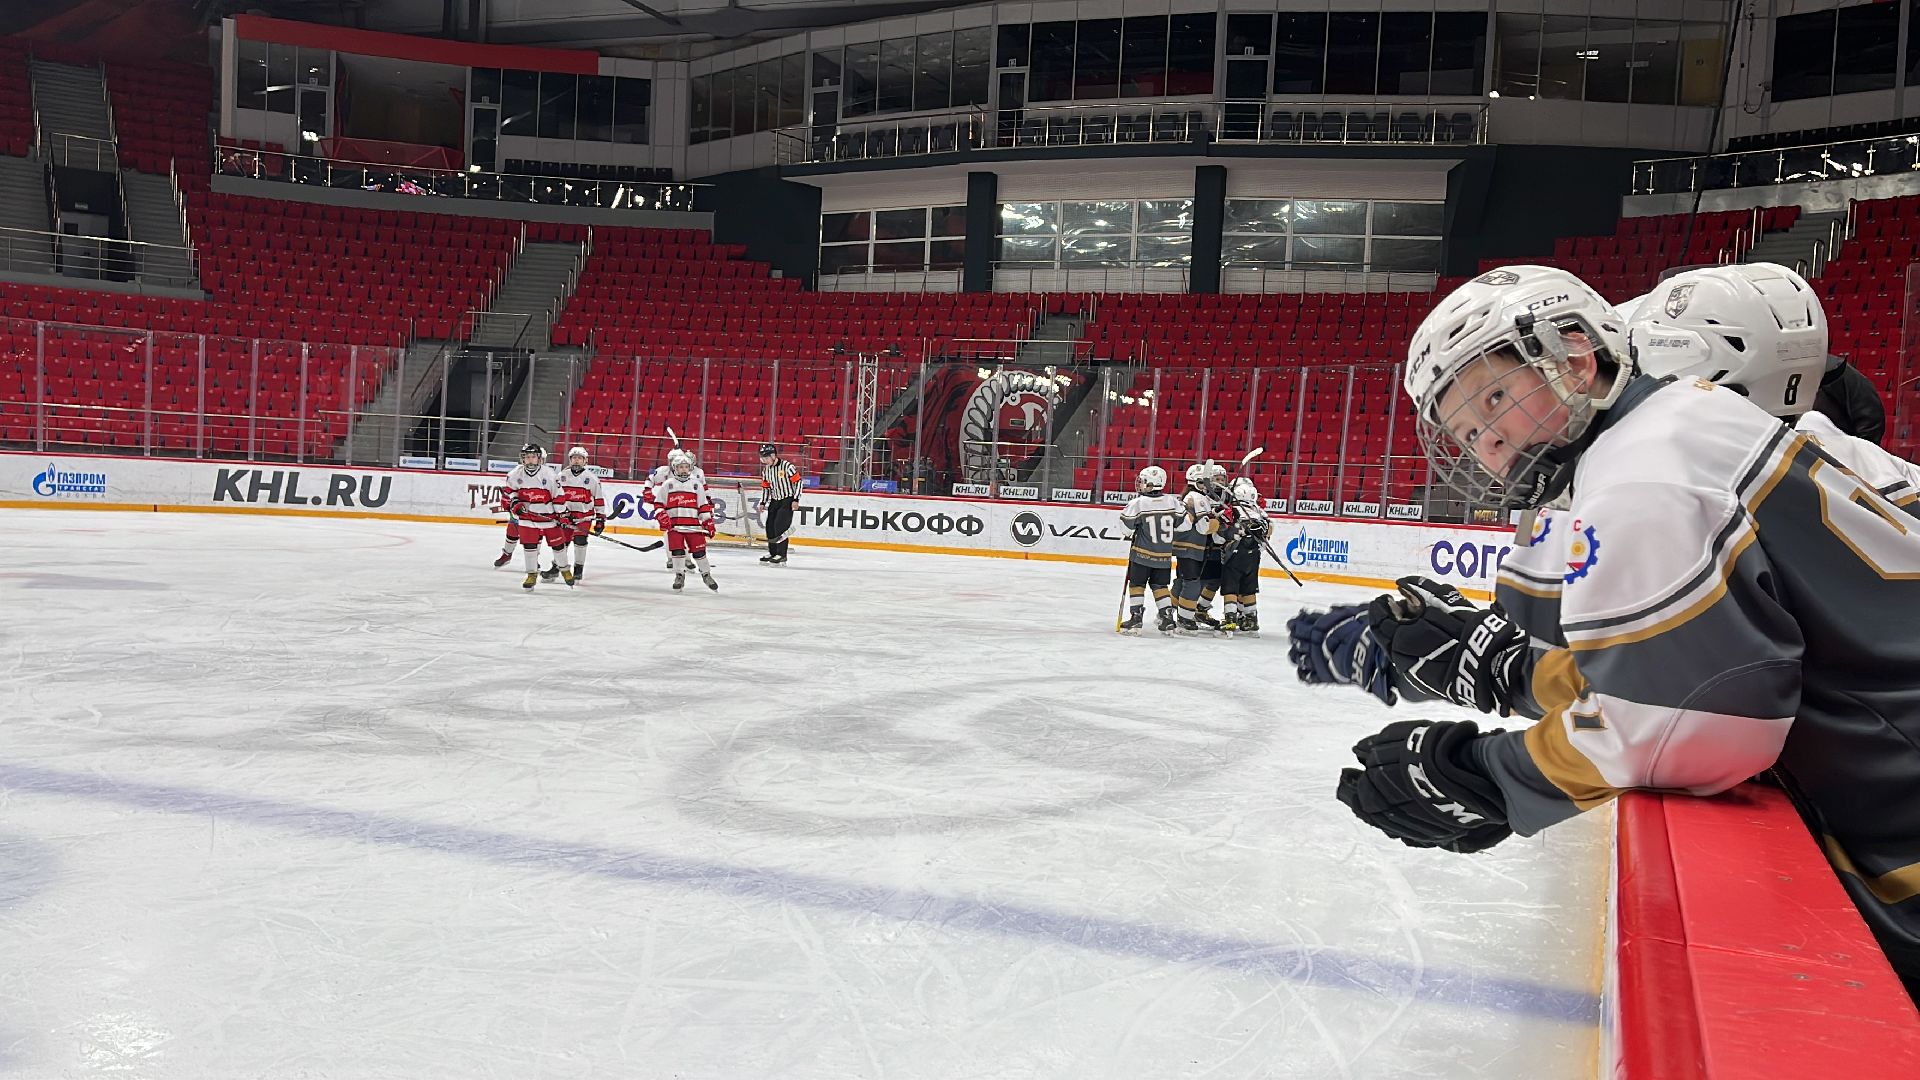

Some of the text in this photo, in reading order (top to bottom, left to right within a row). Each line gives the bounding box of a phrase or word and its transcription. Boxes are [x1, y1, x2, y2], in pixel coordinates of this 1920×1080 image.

[1528, 294, 1569, 313] CCM
[1409, 342, 1431, 387] CCM
[1784, 373, 1802, 406] 8
[57, 471, 106, 485] ГАЗПРОМ
[212, 468, 393, 508] KHL.RU
[955, 485, 987, 495] KHL.RU
[1054, 490, 1089, 500] KHL.RU
[1298, 501, 1331, 512] KHL.RU
[1345, 504, 1377, 514] KHL.RU
[1388, 506, 1420, 516] KHL.RU
[793, 505, 985, 537] ТИНЬКОФФ
[1144, 515, 1175, 544] 19
[1048, 523, 1134, 542] VAL
[1307, 538, 1349, 554] ГАЗПРОМ
[1406, 725, 1485, 824] CCM
